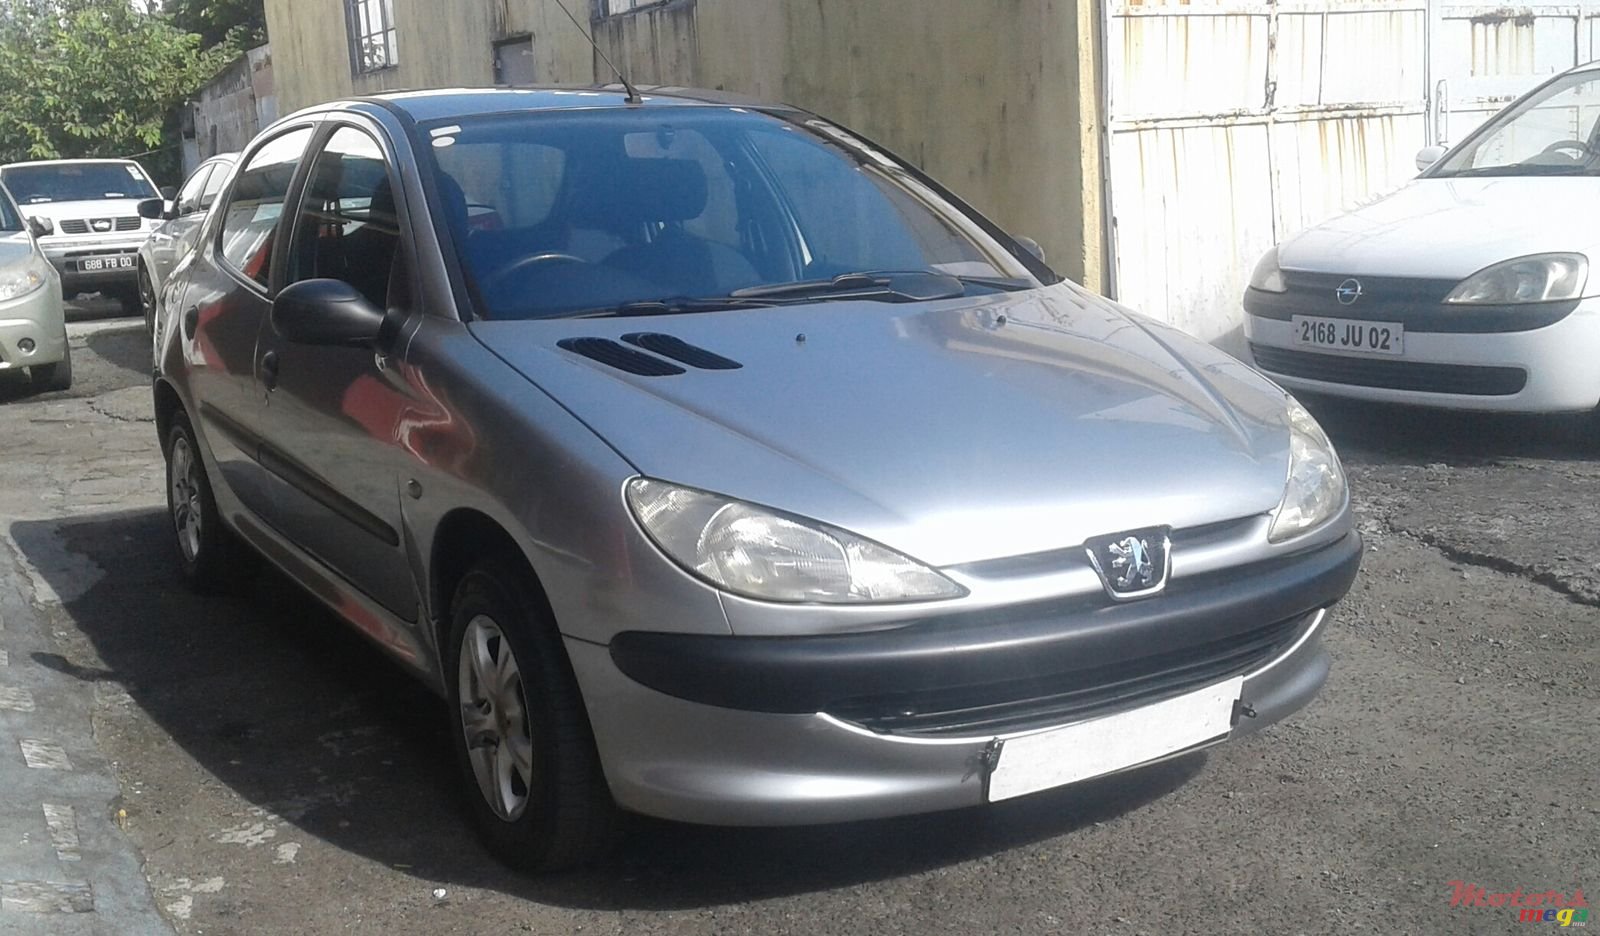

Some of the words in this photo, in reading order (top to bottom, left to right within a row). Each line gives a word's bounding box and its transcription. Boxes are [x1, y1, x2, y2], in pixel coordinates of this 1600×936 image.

[85, 260, 102, 270] 688
[105, 258, 117, 268] FB
[120, 256, 132, 267] 00
[1301, 321, 1336, 345] 2168
[1340, 324, 1363, 347] JU
[1369, 326, 1391, 350] 02
